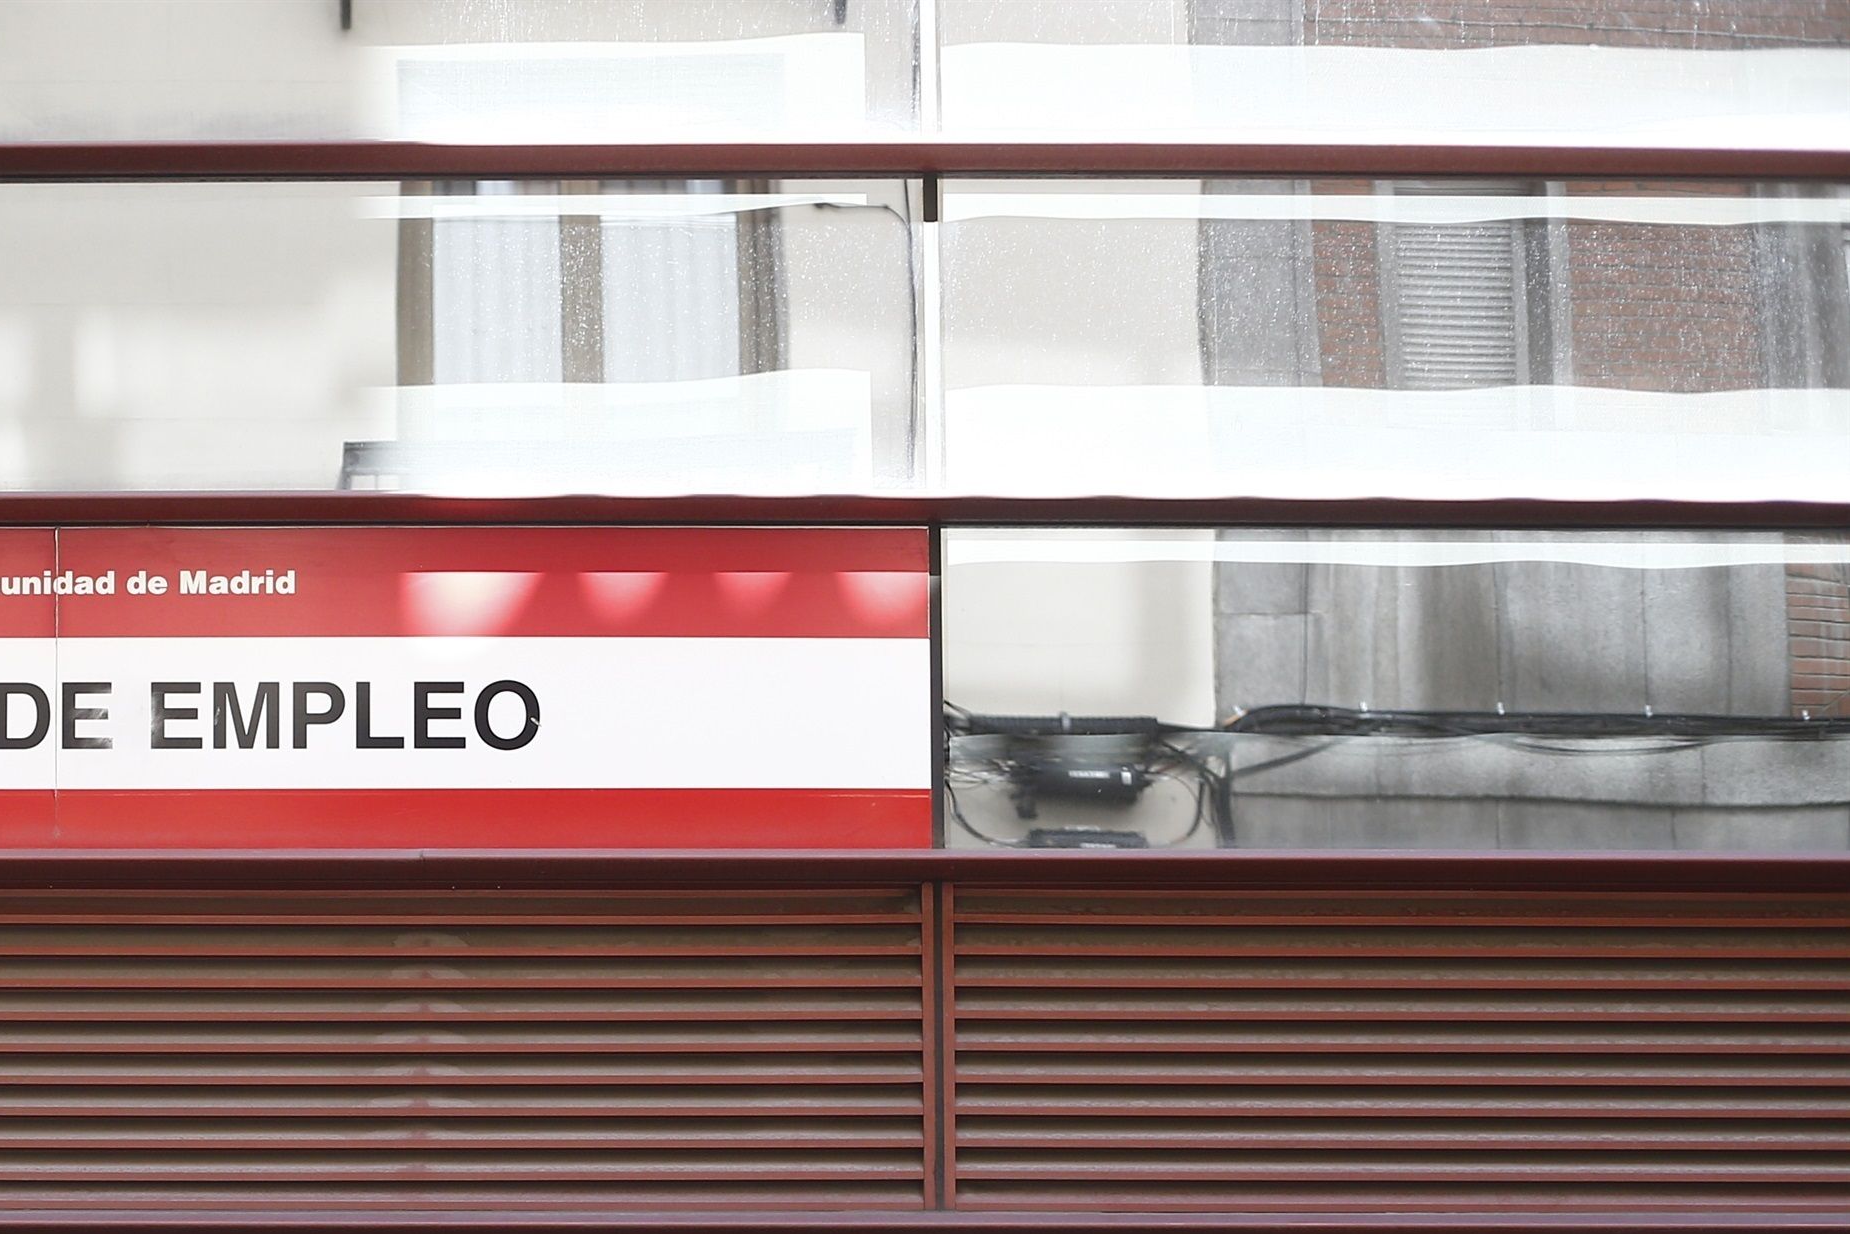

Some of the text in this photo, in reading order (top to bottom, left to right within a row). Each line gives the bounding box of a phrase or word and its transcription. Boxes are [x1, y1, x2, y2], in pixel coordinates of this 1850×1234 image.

[125, 568, 170, 597] de
[179, 568, 298, 598] Madrid
[150, 679, 543, 751] EMPLEO
